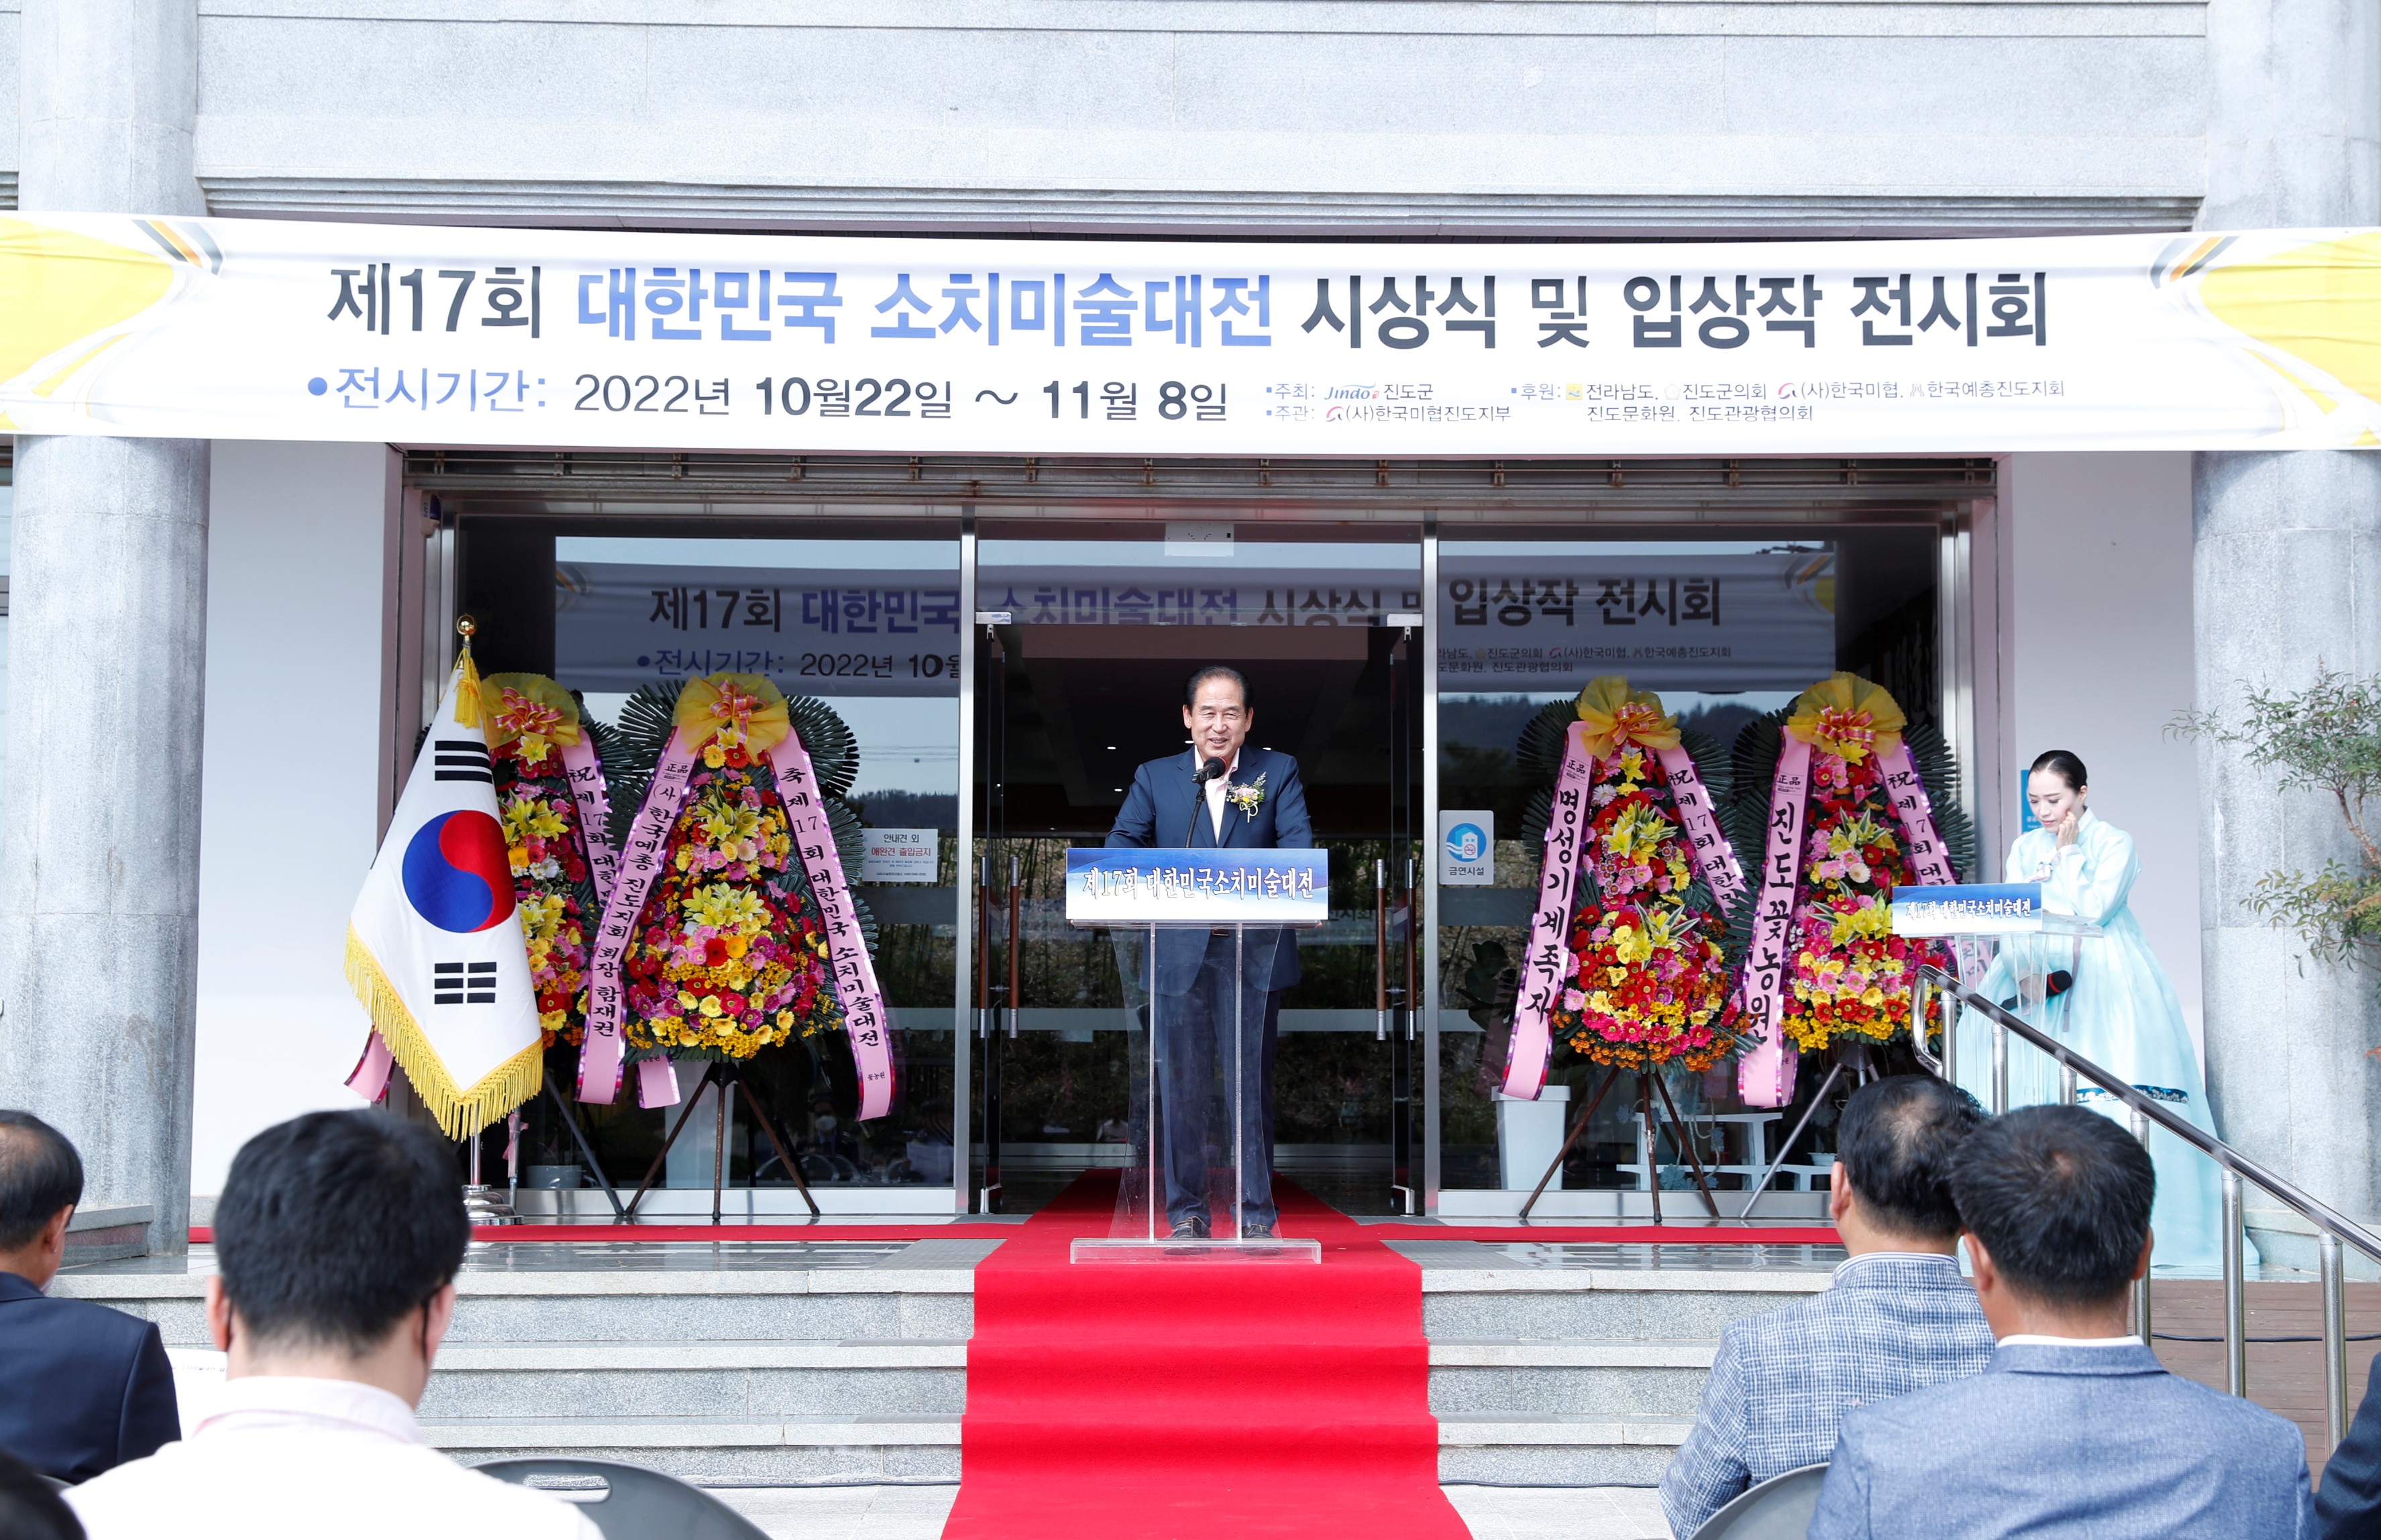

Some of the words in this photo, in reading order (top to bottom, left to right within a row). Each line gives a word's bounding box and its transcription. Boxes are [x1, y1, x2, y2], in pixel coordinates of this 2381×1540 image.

[327, 263, 541, 338] 제17회
[578, 268, 842, 343] 대한민국
[871, 272, 1271, 347] 소치미술대전
[1301, 275, 1495, 349] 시상식
[1532, 276, 1589, 348] 및
[1624, 274, 1823, 349] 입상작
[1850, 272, 2046, 347] 전시회
[335, 367, 547, 412] 전시기간:
[575, 374, 729, 415] 2022년
[756, 377, 951, 419] 10월22일
[1043, 381, 1136, 420] 11월
[1159, 381, 1226, 421] 8일
[1275, 383, 1315, 400] 주최:
[1383, 384, 1434, 400] 진도군
[1520, 383, 1561, 400] 후원:
[1683, 383, 1766, 400] 진도군의회
[1927, 380, 2065, 398] 한국예총진도지회
[1275, 405, 1315, 422] 주관:
[1346, 404, 1512, 423] (사)한국미협진도지부
[1689, 405, 1813, 423] 진도관광협의회
[649, 587, 781, 632] 제17회
[1448, 578, 1579, 626] 입상작
[1595, 578, 1722, 626] 전시회
[800, 653, 893, 678] 2022년
[884, 834, 907, 843] 안내견
[911, 834, 919, 843] 외
[871, 846, 896, 857] 애완견
[899, 846, 931, 857] 출입금지
[1448, 867, 1485, 876] 금연시설
[1082, 866, 1139, 900] 제17회
[1906, 900, 1936, 921] 제17회
